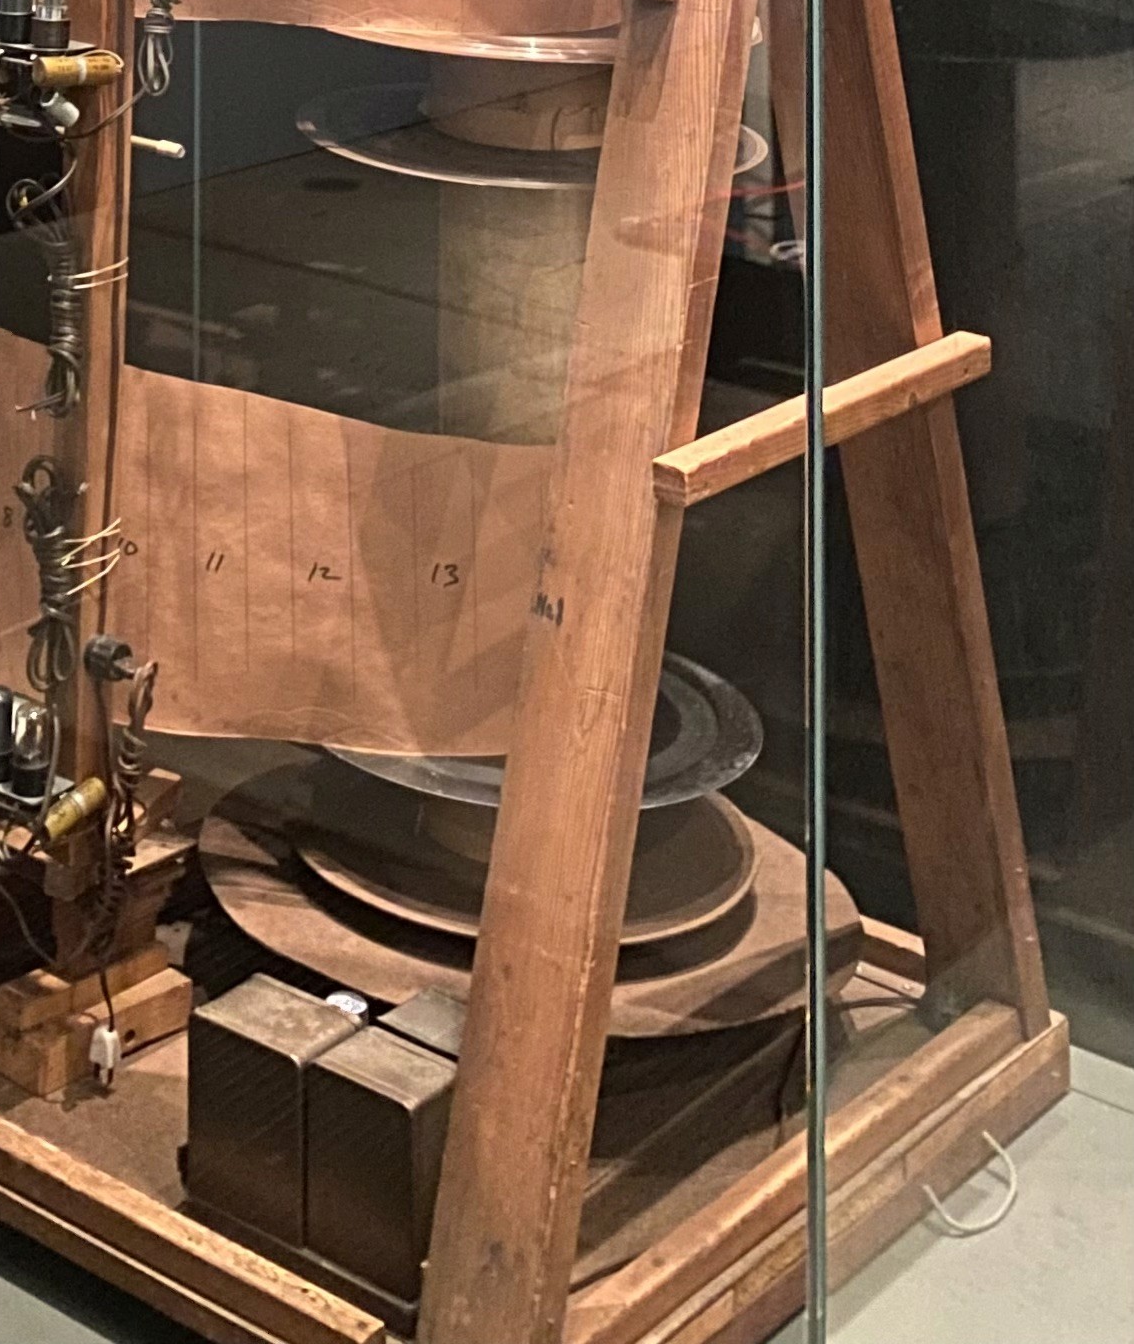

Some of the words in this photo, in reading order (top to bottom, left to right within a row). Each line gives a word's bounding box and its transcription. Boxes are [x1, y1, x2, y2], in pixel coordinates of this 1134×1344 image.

[2, 505, 13, 529] 8
[206, 551, 225, 574] 11
[307, 562, 342, 583] 12
[431, 562, 460, 589] 13
